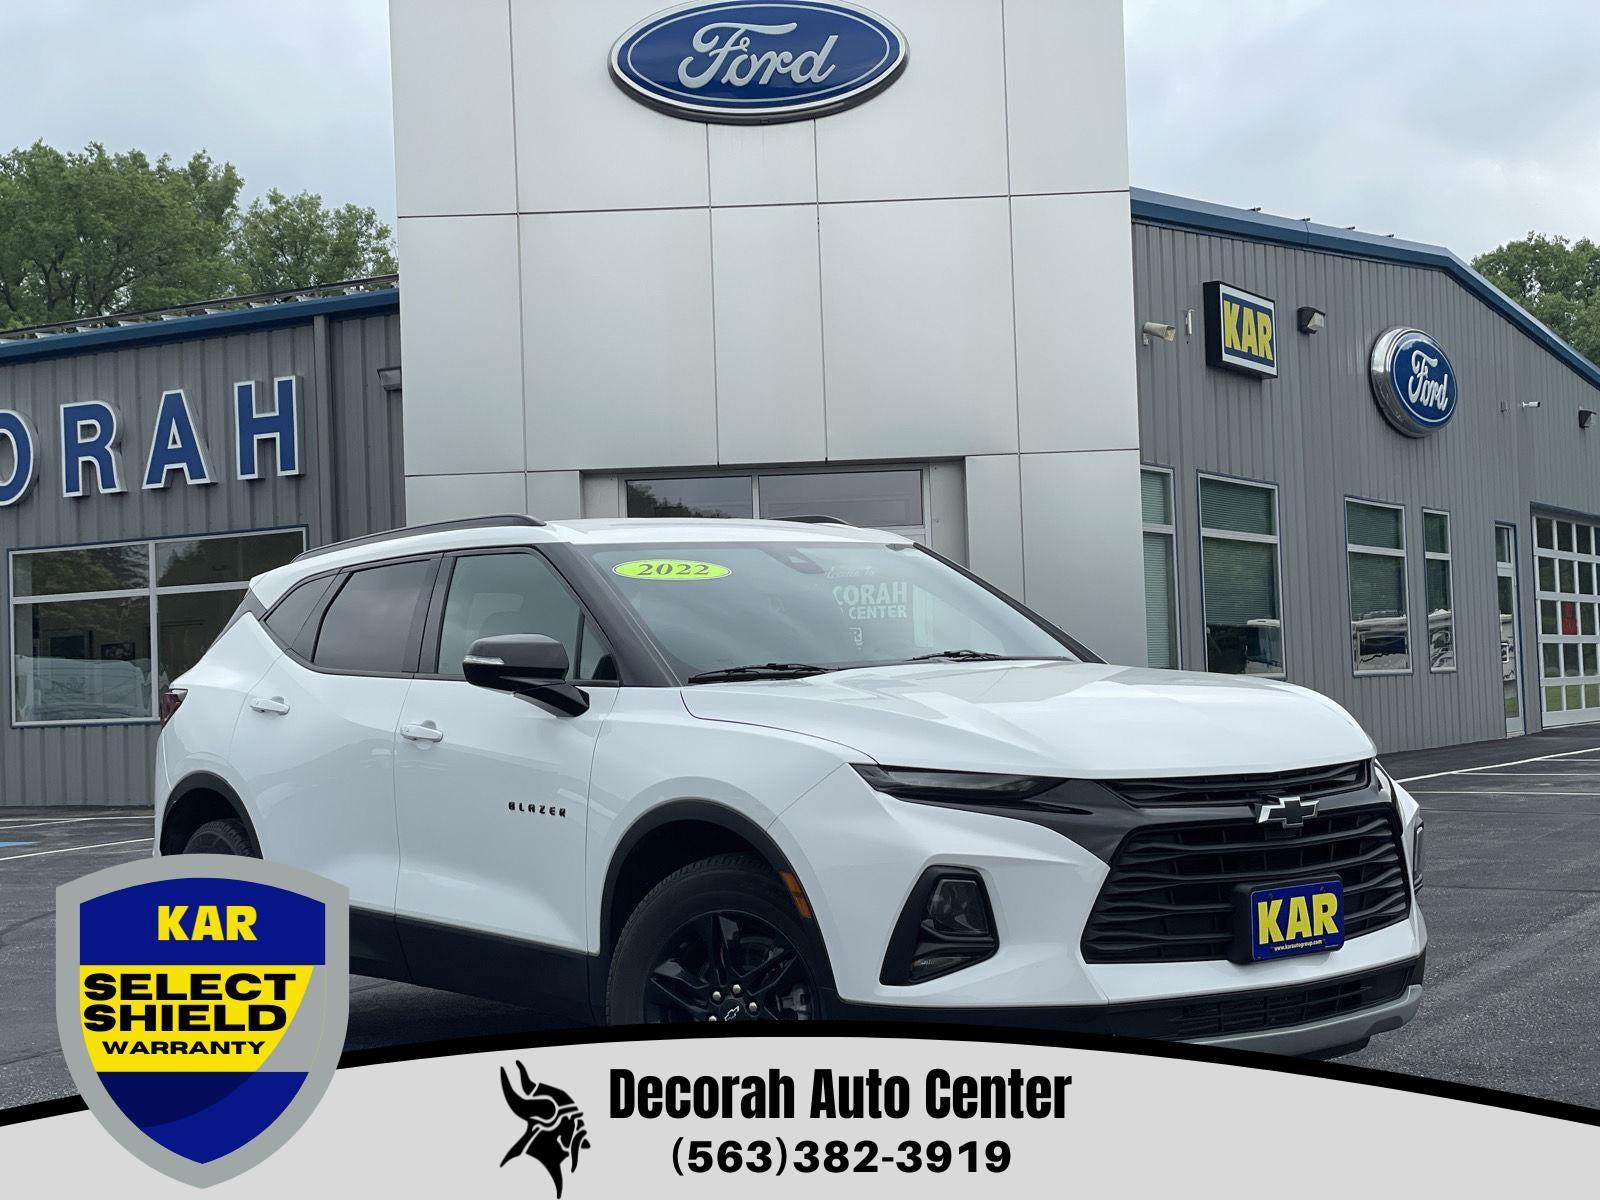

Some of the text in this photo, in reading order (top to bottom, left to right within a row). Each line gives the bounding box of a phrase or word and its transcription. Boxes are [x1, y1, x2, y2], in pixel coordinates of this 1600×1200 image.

[677, 22, 839, 89] Ford
[1223, 300, 1273, 360] KAR
[1407, 349, 1449, 412] Ford
[637, 563, 710, 577] 2022
[508, 801, 566, 818] BLAZER
[1257, 892, 1339, 945] KAR
[1274, 939, 1323, 952] www.karautogroup.com
